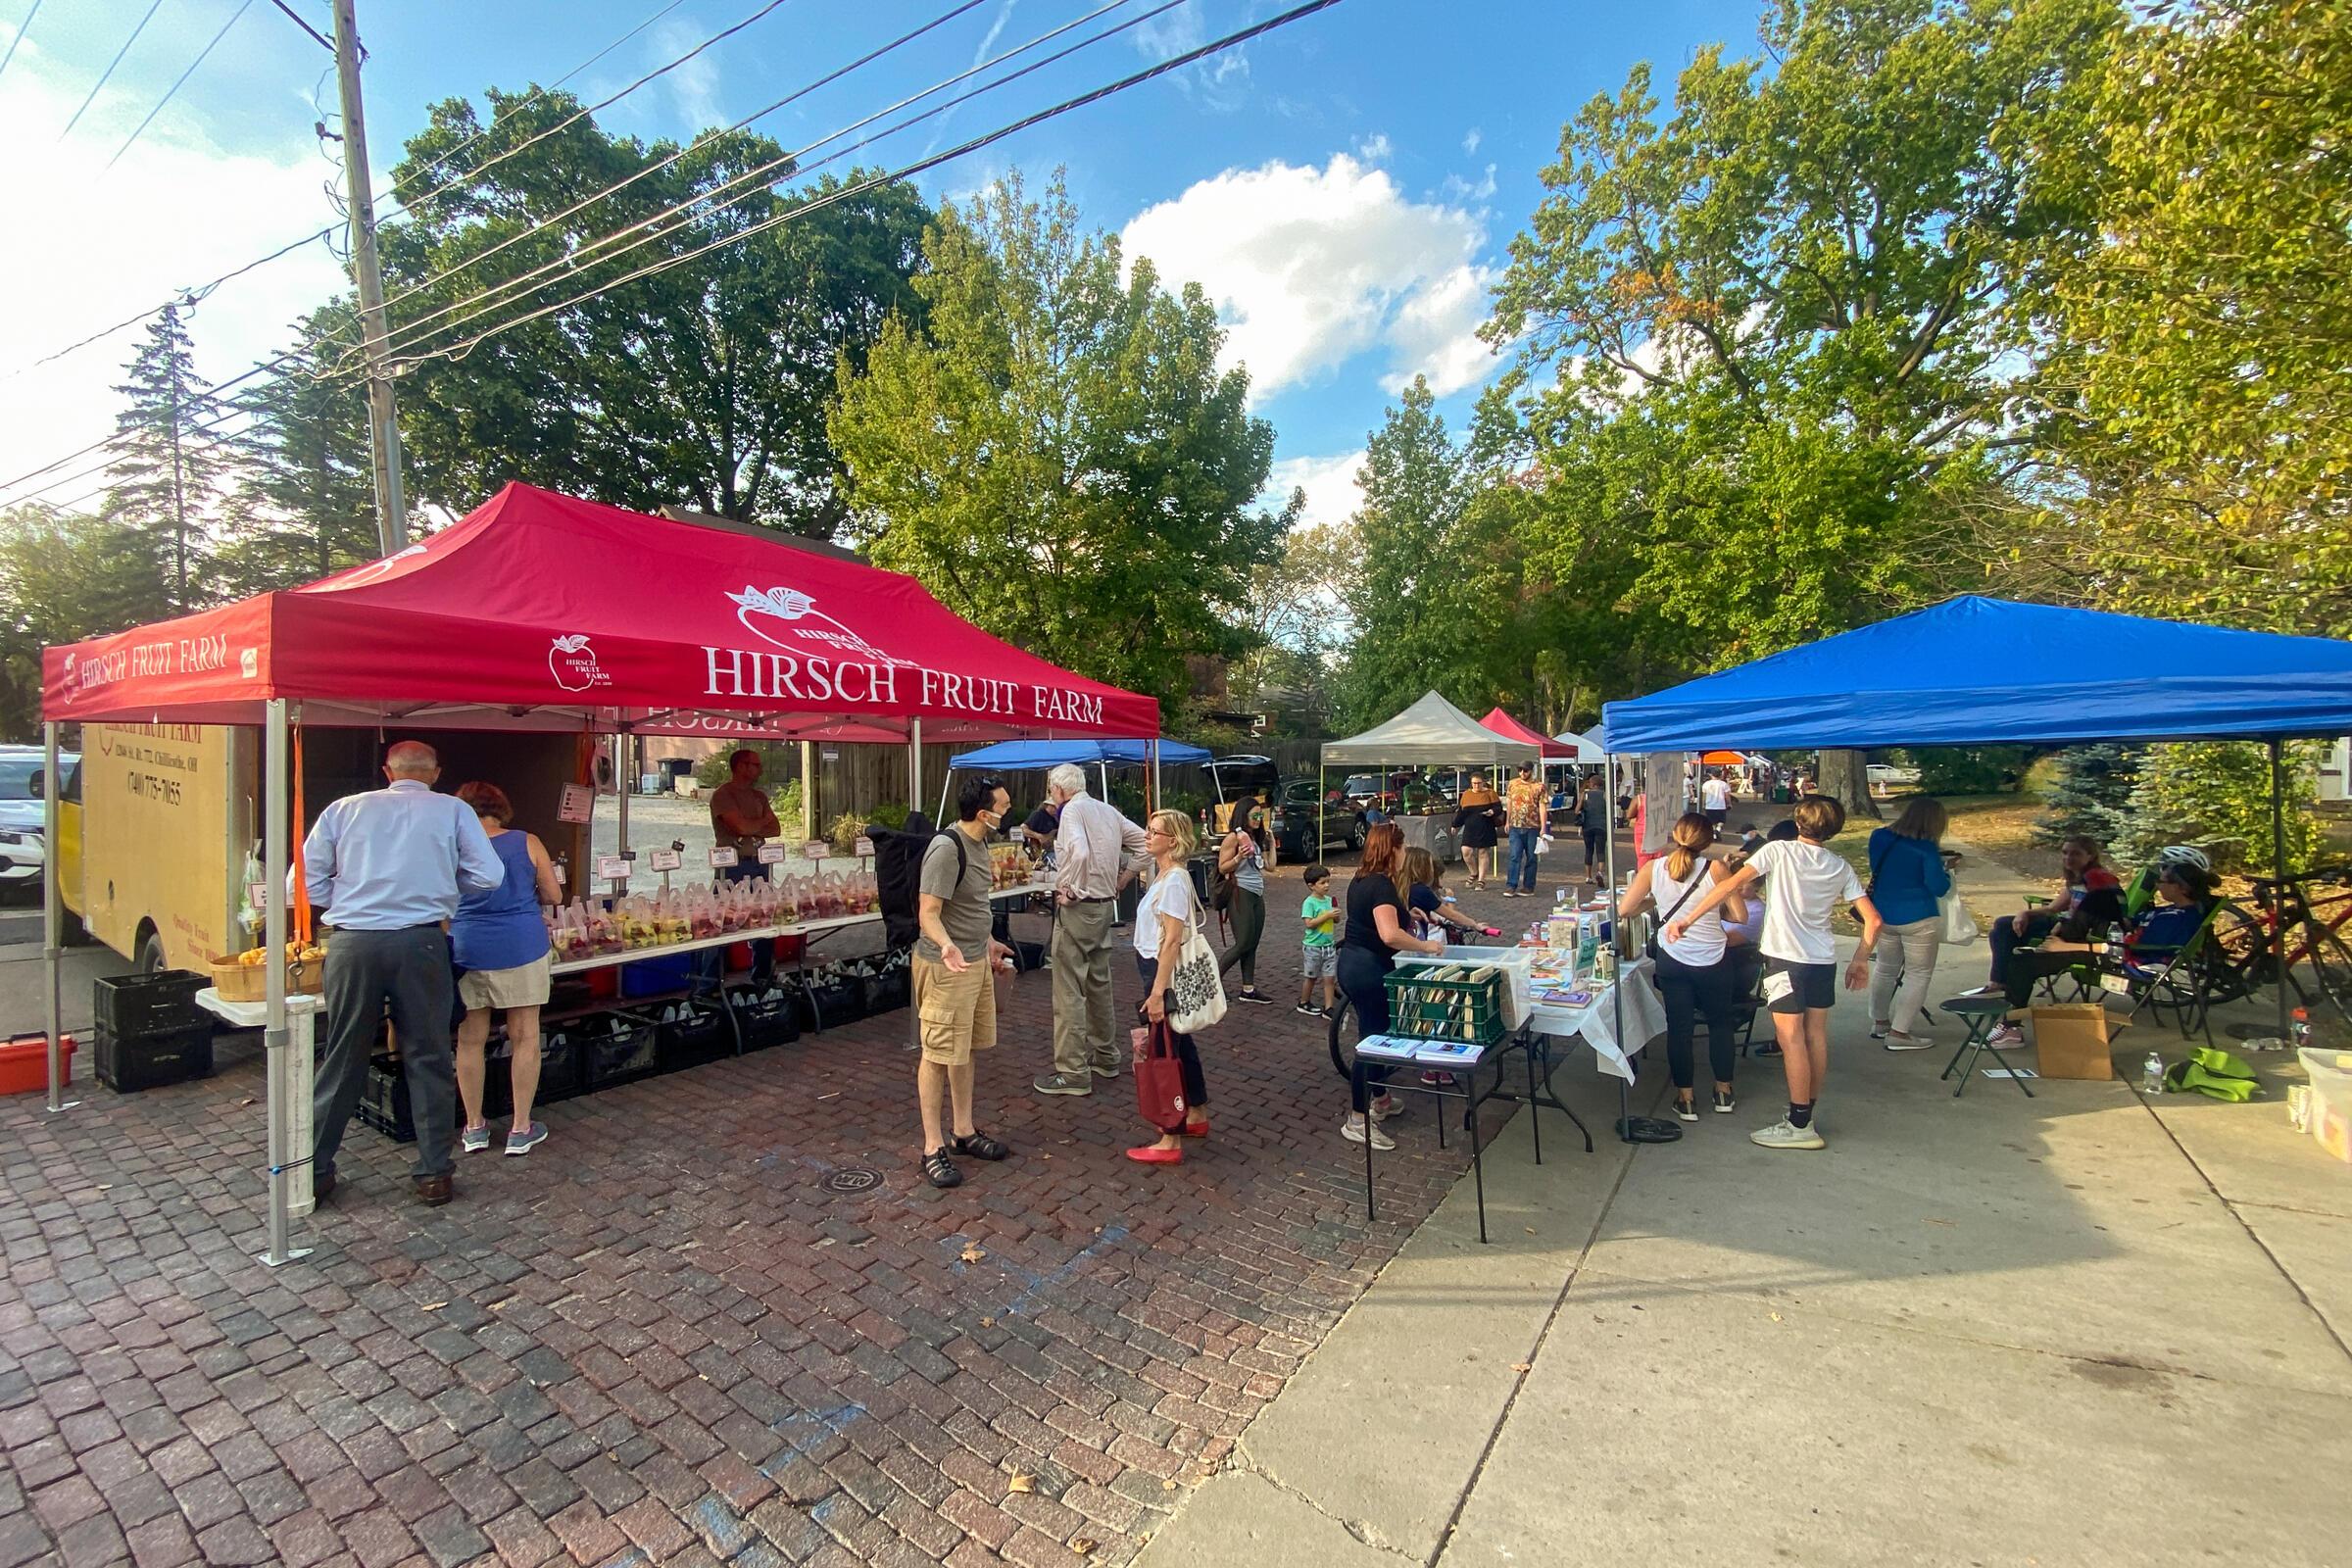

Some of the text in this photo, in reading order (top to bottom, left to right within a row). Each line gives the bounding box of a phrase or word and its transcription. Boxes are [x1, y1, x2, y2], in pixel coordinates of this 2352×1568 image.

[81, 651, 126, 690] HIRSCH
[131, 643, 173, 677] FRUIT
[180, 633, 227, 673] FARM
[792, 628, 870, 648] HIRSCH
[700, 646, 1104, 725] HIRSCH FRUIT FARM
